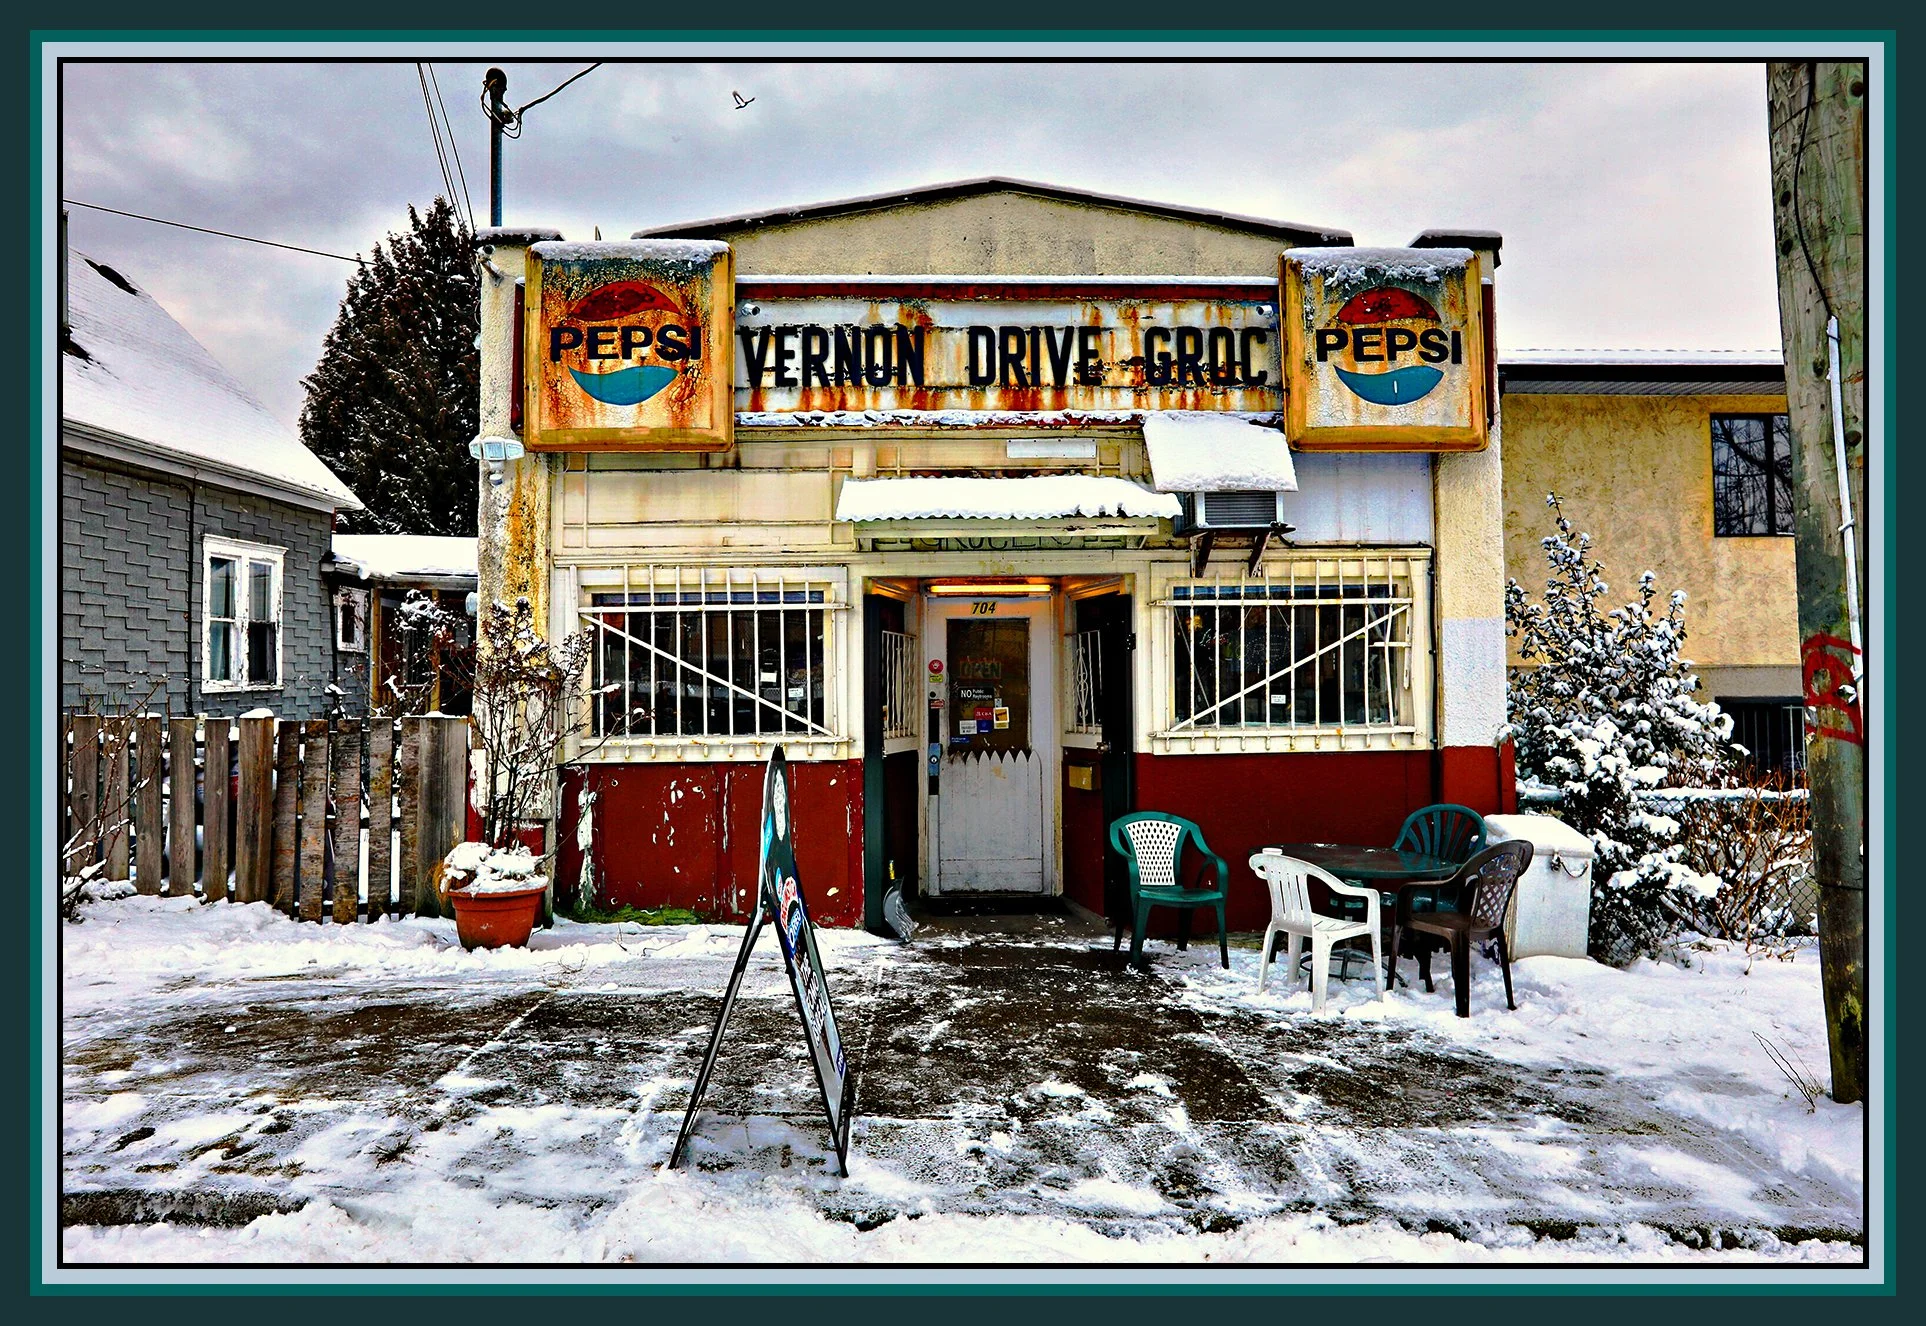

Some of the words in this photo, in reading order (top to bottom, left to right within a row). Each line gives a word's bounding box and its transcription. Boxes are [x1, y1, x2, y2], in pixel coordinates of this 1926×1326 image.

[550, 326, 700, 362] PEPSI
[740, 325, 925, 388] VERNON
[968, 326, 1101, 387] DRIVE
[1144, 326, 1268, 386] GROC
[1316, 328, 1462, 364] PEPSI
[972, 601, 997, 615] 704
[960, 689, 972, 698] NO
